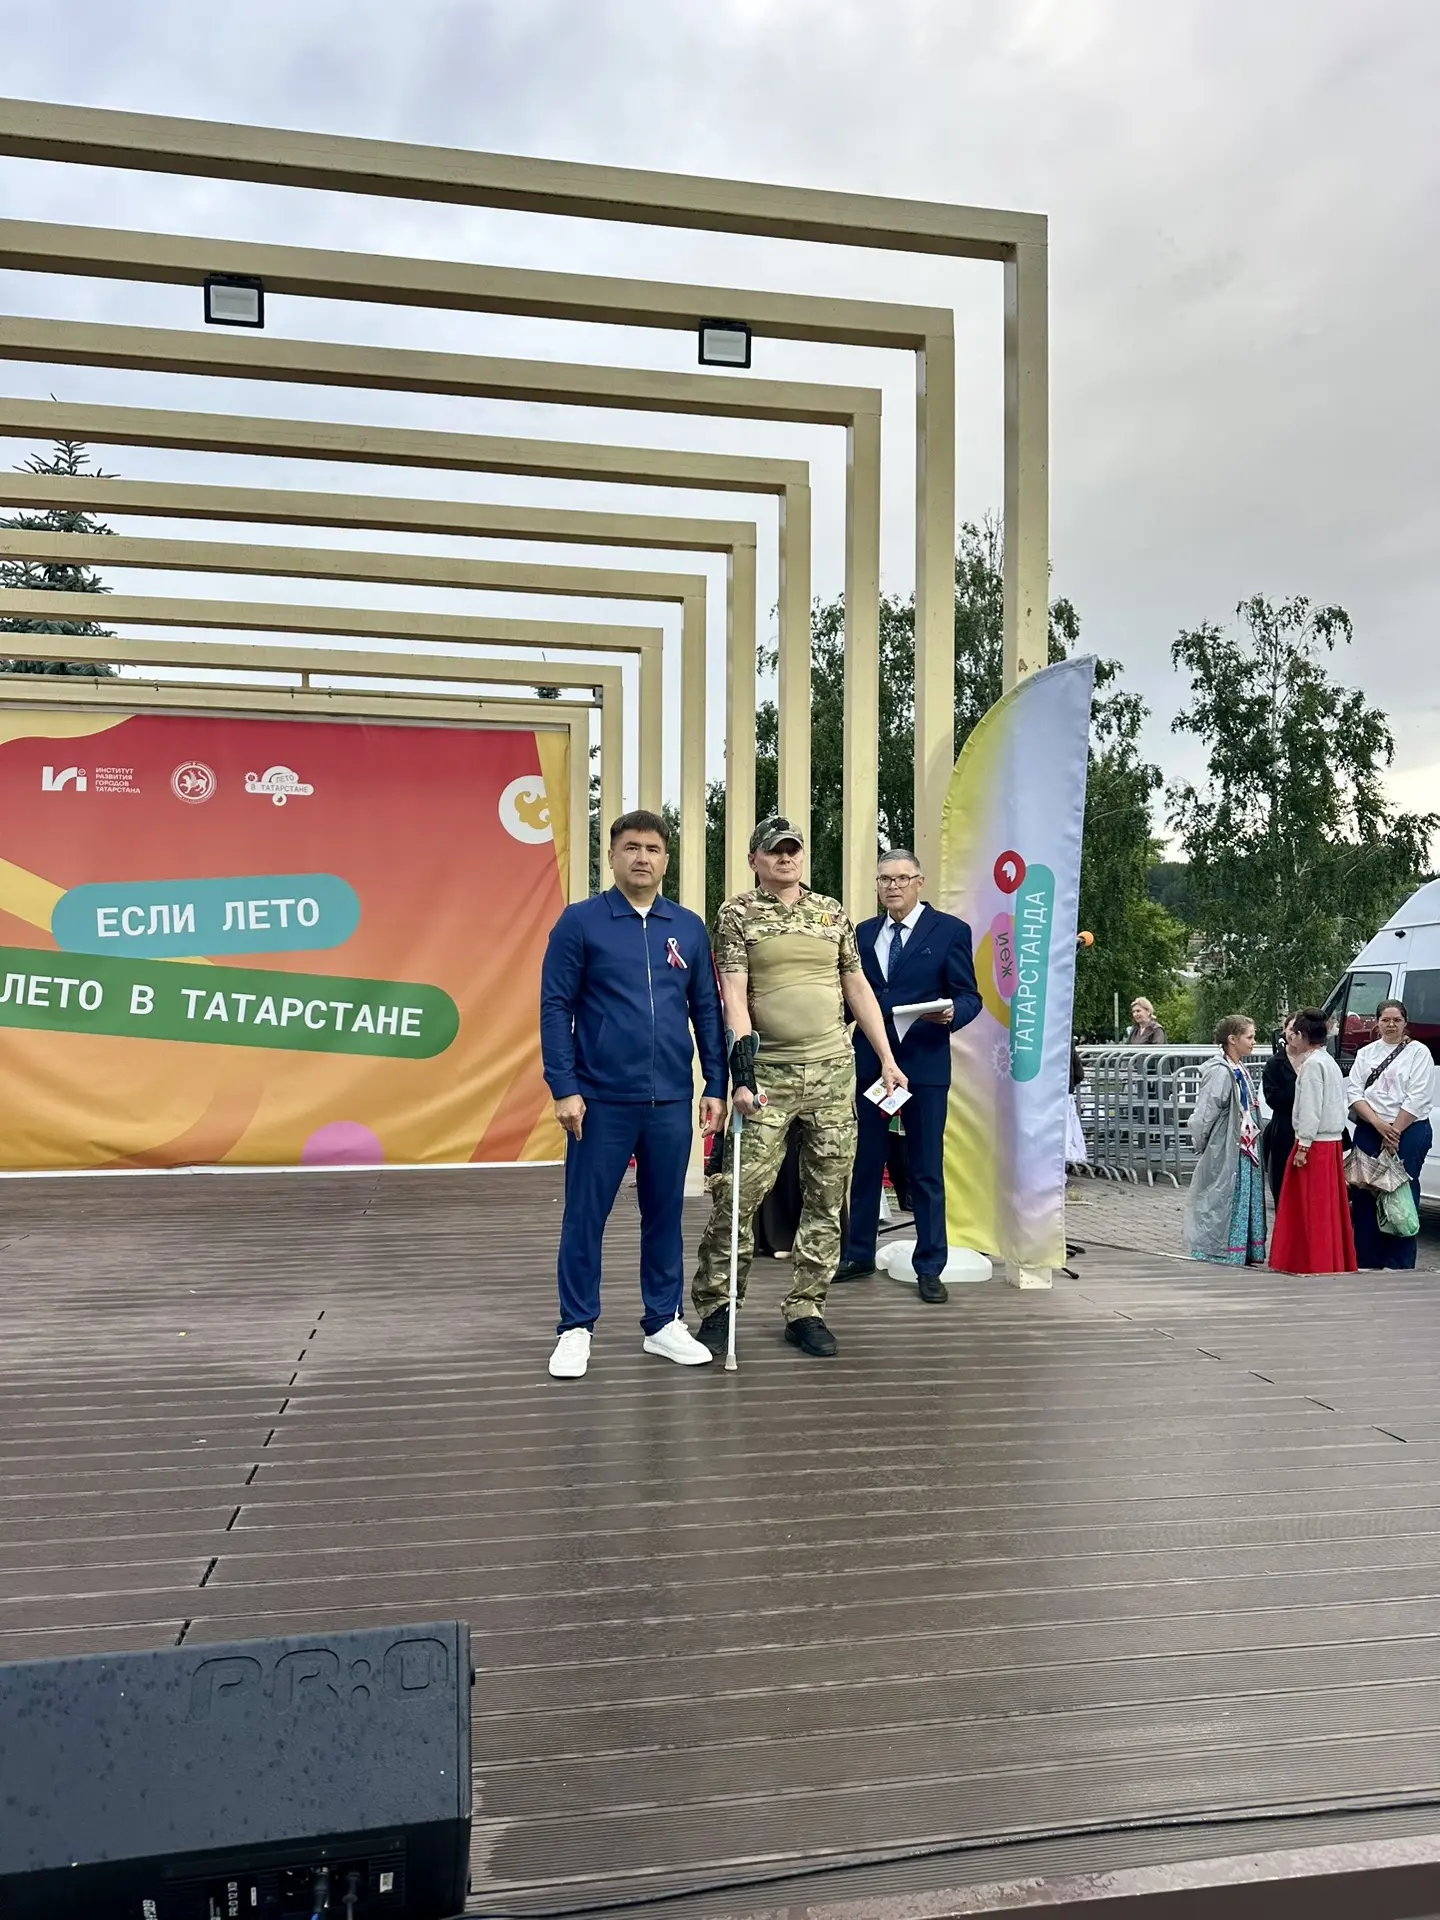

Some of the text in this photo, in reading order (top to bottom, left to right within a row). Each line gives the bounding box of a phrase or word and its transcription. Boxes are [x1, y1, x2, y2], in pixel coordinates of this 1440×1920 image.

[95, 786, 141, 794] ТАТАРСТАНА
[261, 784, 309, 793] ТАТАРСТАНЕ
[275, 774, 295, 783] ЛЕТО
[96, 897, 320, 938] ЕСЛИ ЛЕТО
[1013, 891, 1047, 1055] ТАТАРСТАНДА
[0, 972, 424, 1038] ЛЕТО В ТАТАРСТАНЕ
